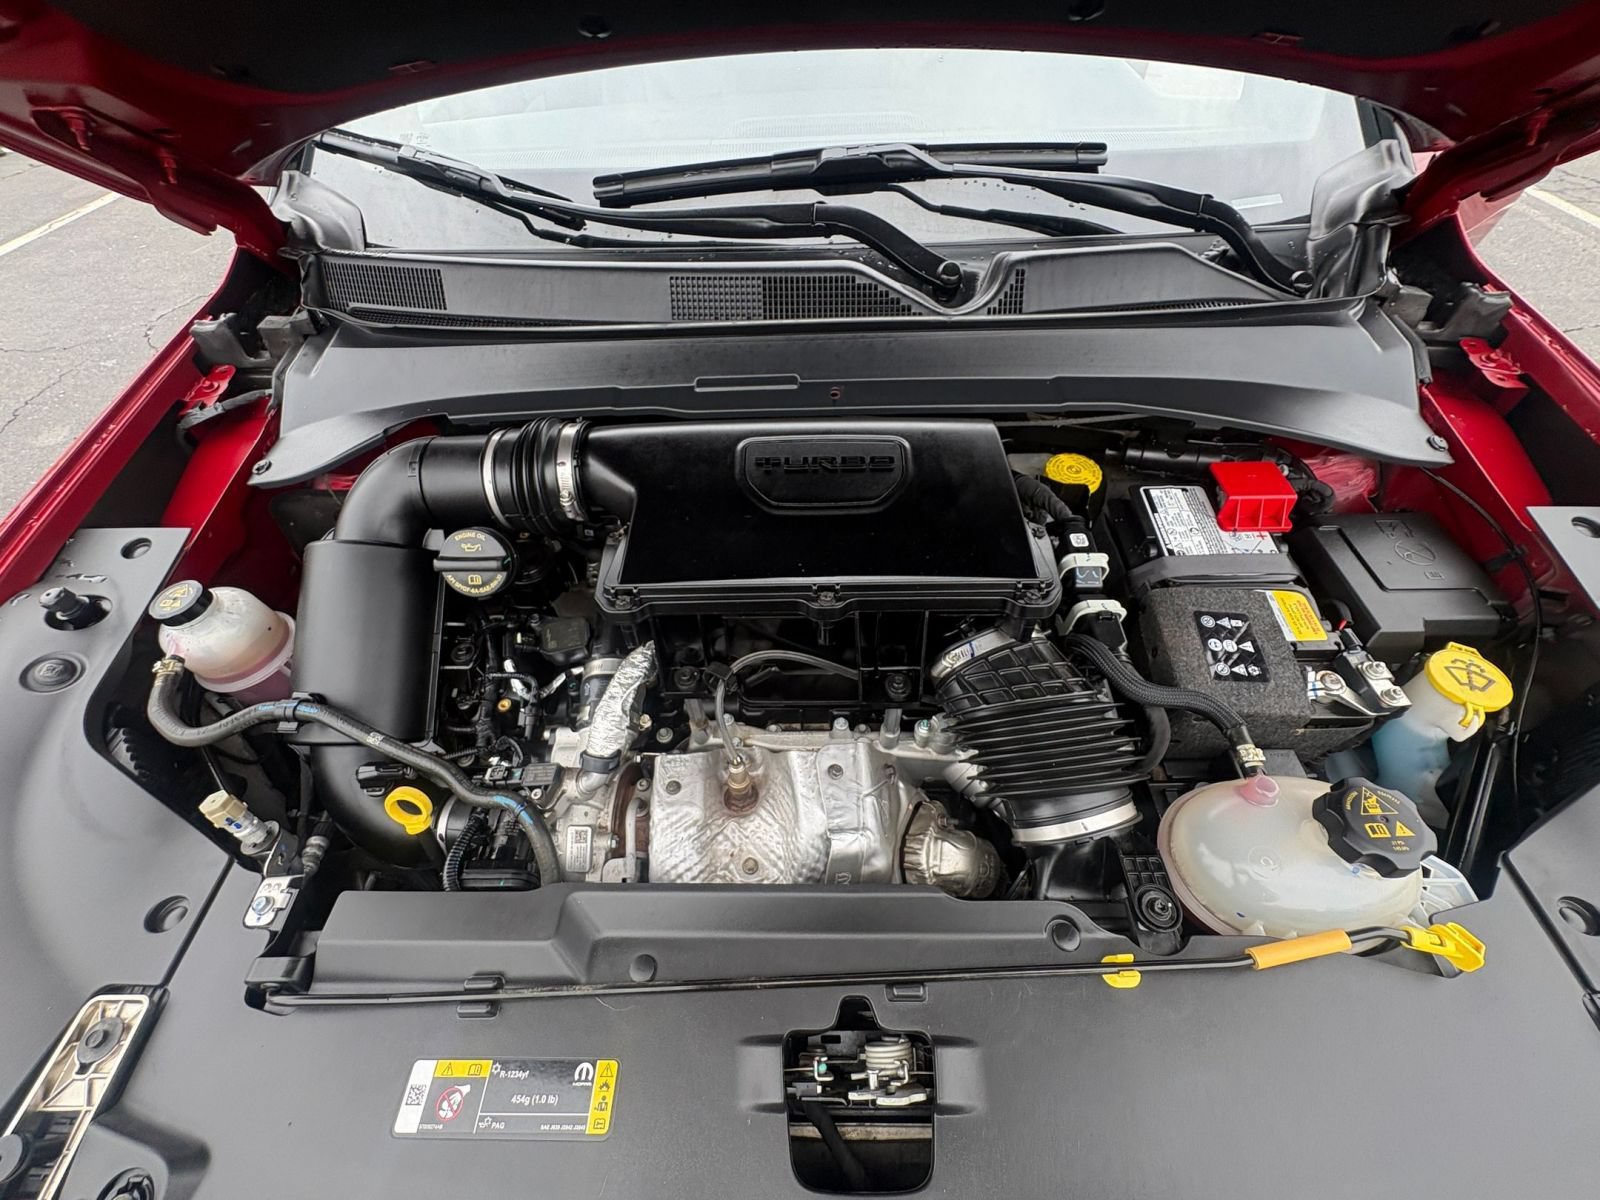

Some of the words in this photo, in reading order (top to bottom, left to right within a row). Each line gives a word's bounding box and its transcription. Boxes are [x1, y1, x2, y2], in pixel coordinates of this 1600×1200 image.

[755, 455, 896, 474] TURBO
[454, 532, 476, 541] ENGINE
[476, 533, 486, 541] OIL
[499, 1070, 529, 1080] R-1234yf
[511, 1096, 531, 1106] 454g
[531, 1095, 546, 1106] (1.0
[547, 1095, 559, 1106] lb)
[491, 1121, 505, 1129] PAG
